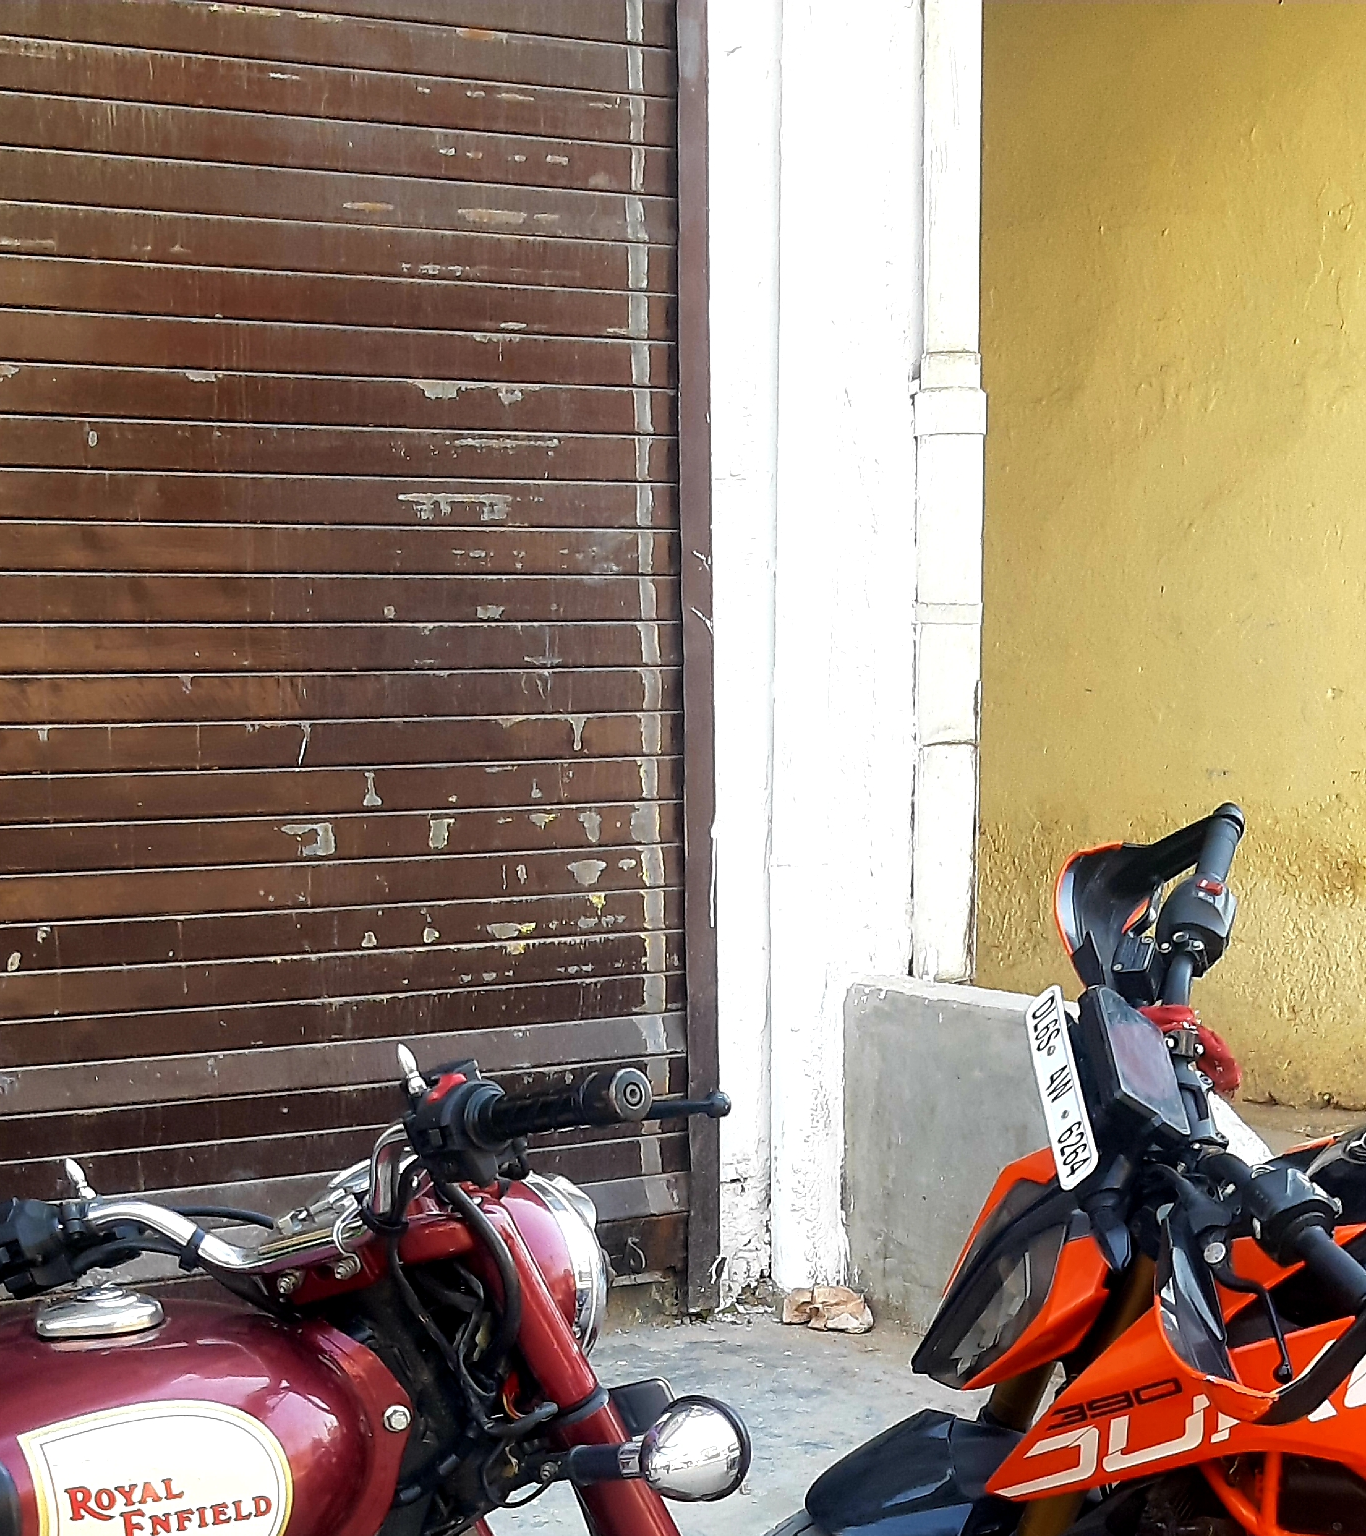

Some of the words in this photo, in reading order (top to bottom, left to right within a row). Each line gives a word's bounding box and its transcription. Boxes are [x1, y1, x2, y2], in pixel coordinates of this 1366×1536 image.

[1045, 1064, 1074, 1103] AW
[1057, 1120, 1091, 1179] 6264
[1047, 1378, 1183, 1432] 390
[64, 1478, 185, 1522] ROYAL
